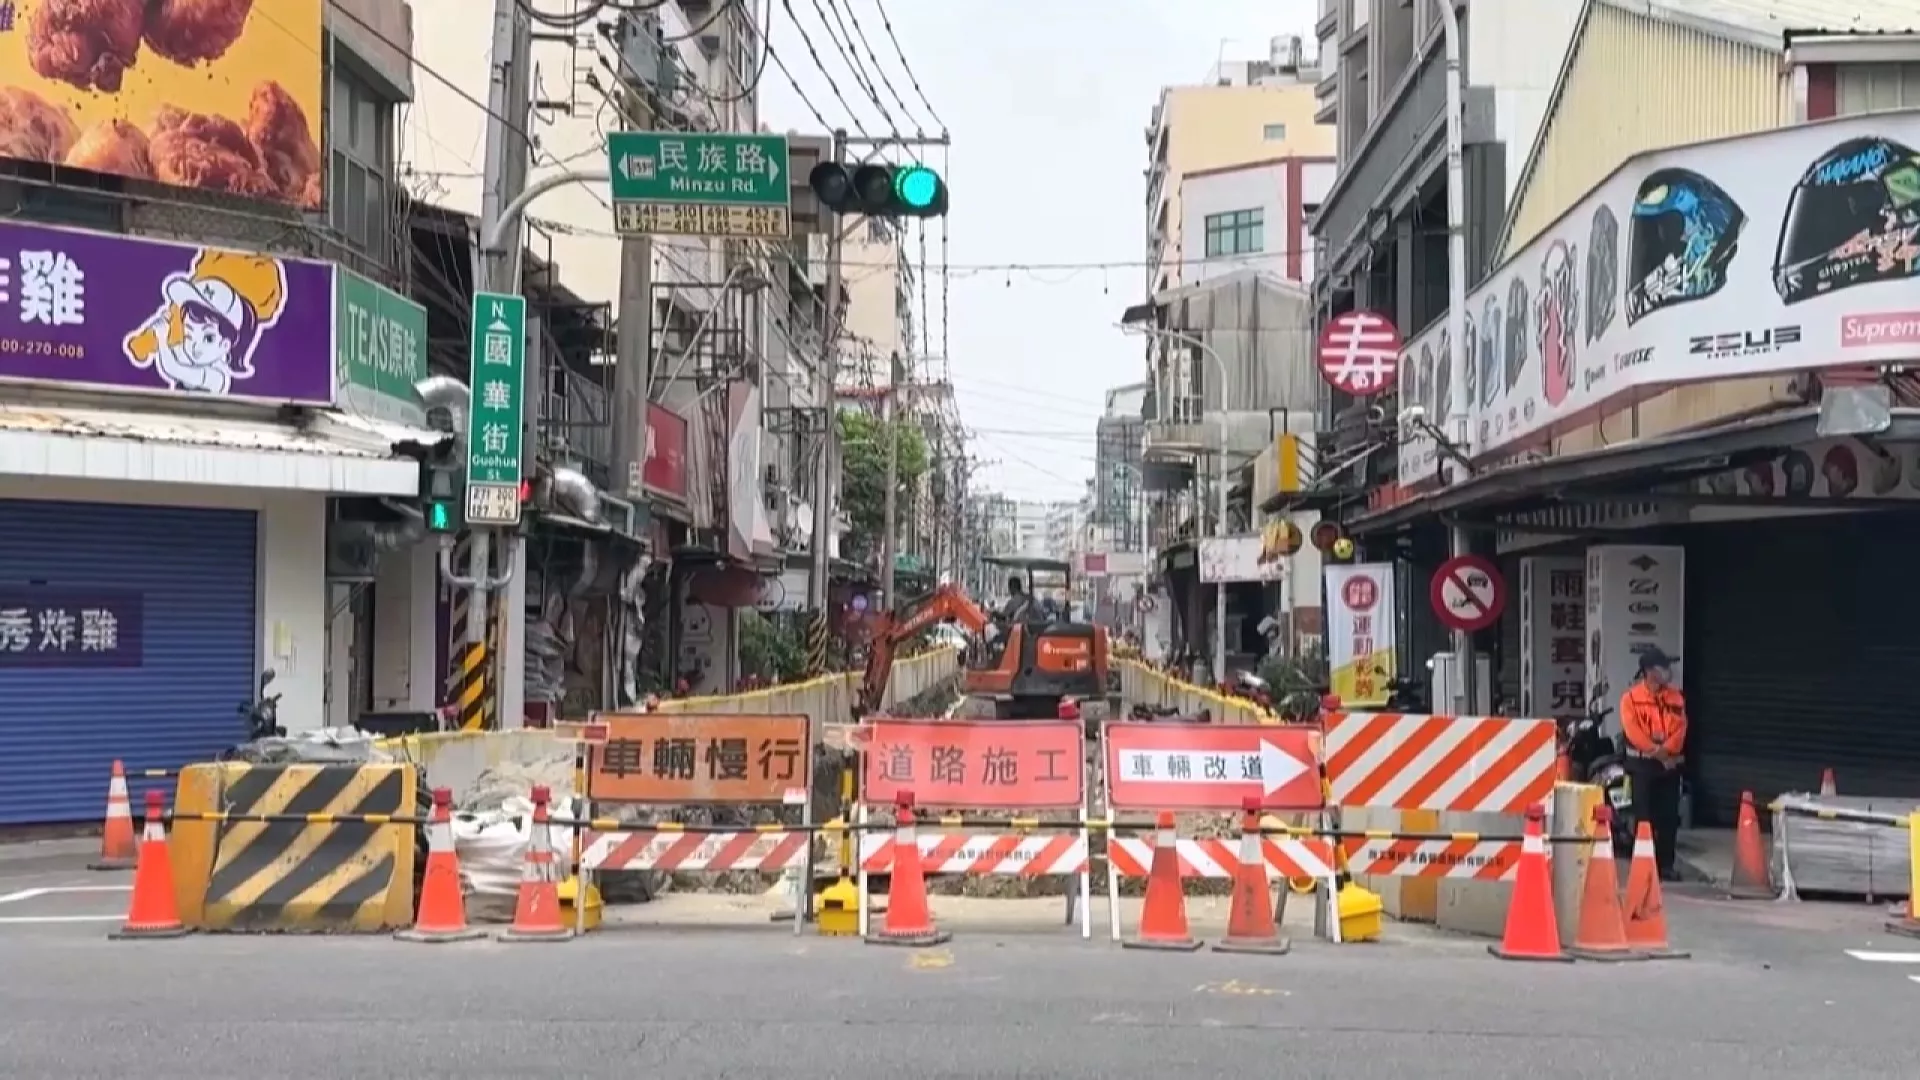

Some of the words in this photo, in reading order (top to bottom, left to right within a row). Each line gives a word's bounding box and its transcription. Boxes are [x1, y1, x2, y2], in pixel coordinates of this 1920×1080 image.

[658, 140, 766, 174] 民族路
[670, 176, 725, 192] Minzu
[731, 178, 758, 193] Rd.
[1689, 325, 1801, 354] ZEUS
[482, 332, 511, 455] 國華街
[472, 454, 517, 468] Guohua
[0, 608, 118, 652] 秀炸雞
[600, 737, 800, 780] 車輛慢行
[879, 743, 1069, 786] 道路施工
[1132, 752, 1264, 780] 車輛改道
